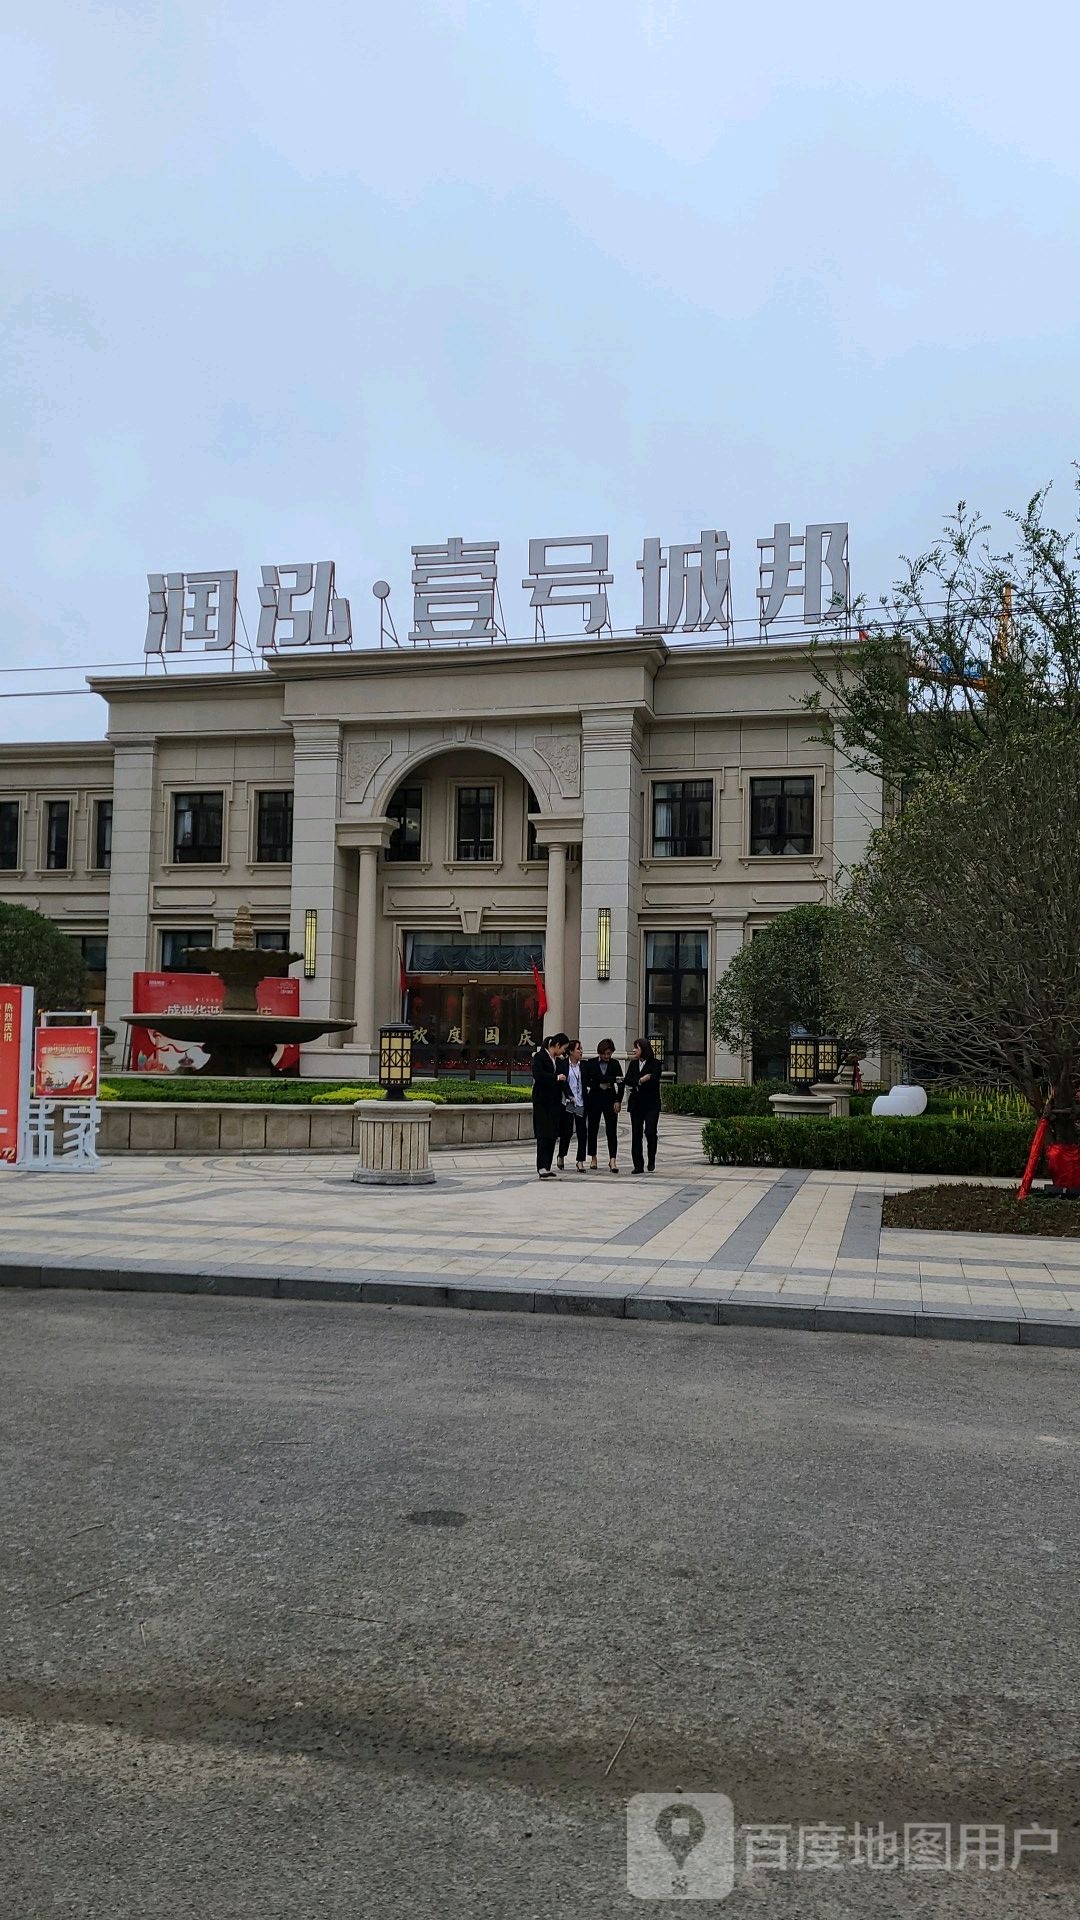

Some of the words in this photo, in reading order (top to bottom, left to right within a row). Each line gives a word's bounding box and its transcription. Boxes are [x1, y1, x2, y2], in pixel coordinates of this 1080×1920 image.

[4, 1002, 14, 1042] 热烈庆祝
[412, 1026, 536, 1047] 欢度国庆
